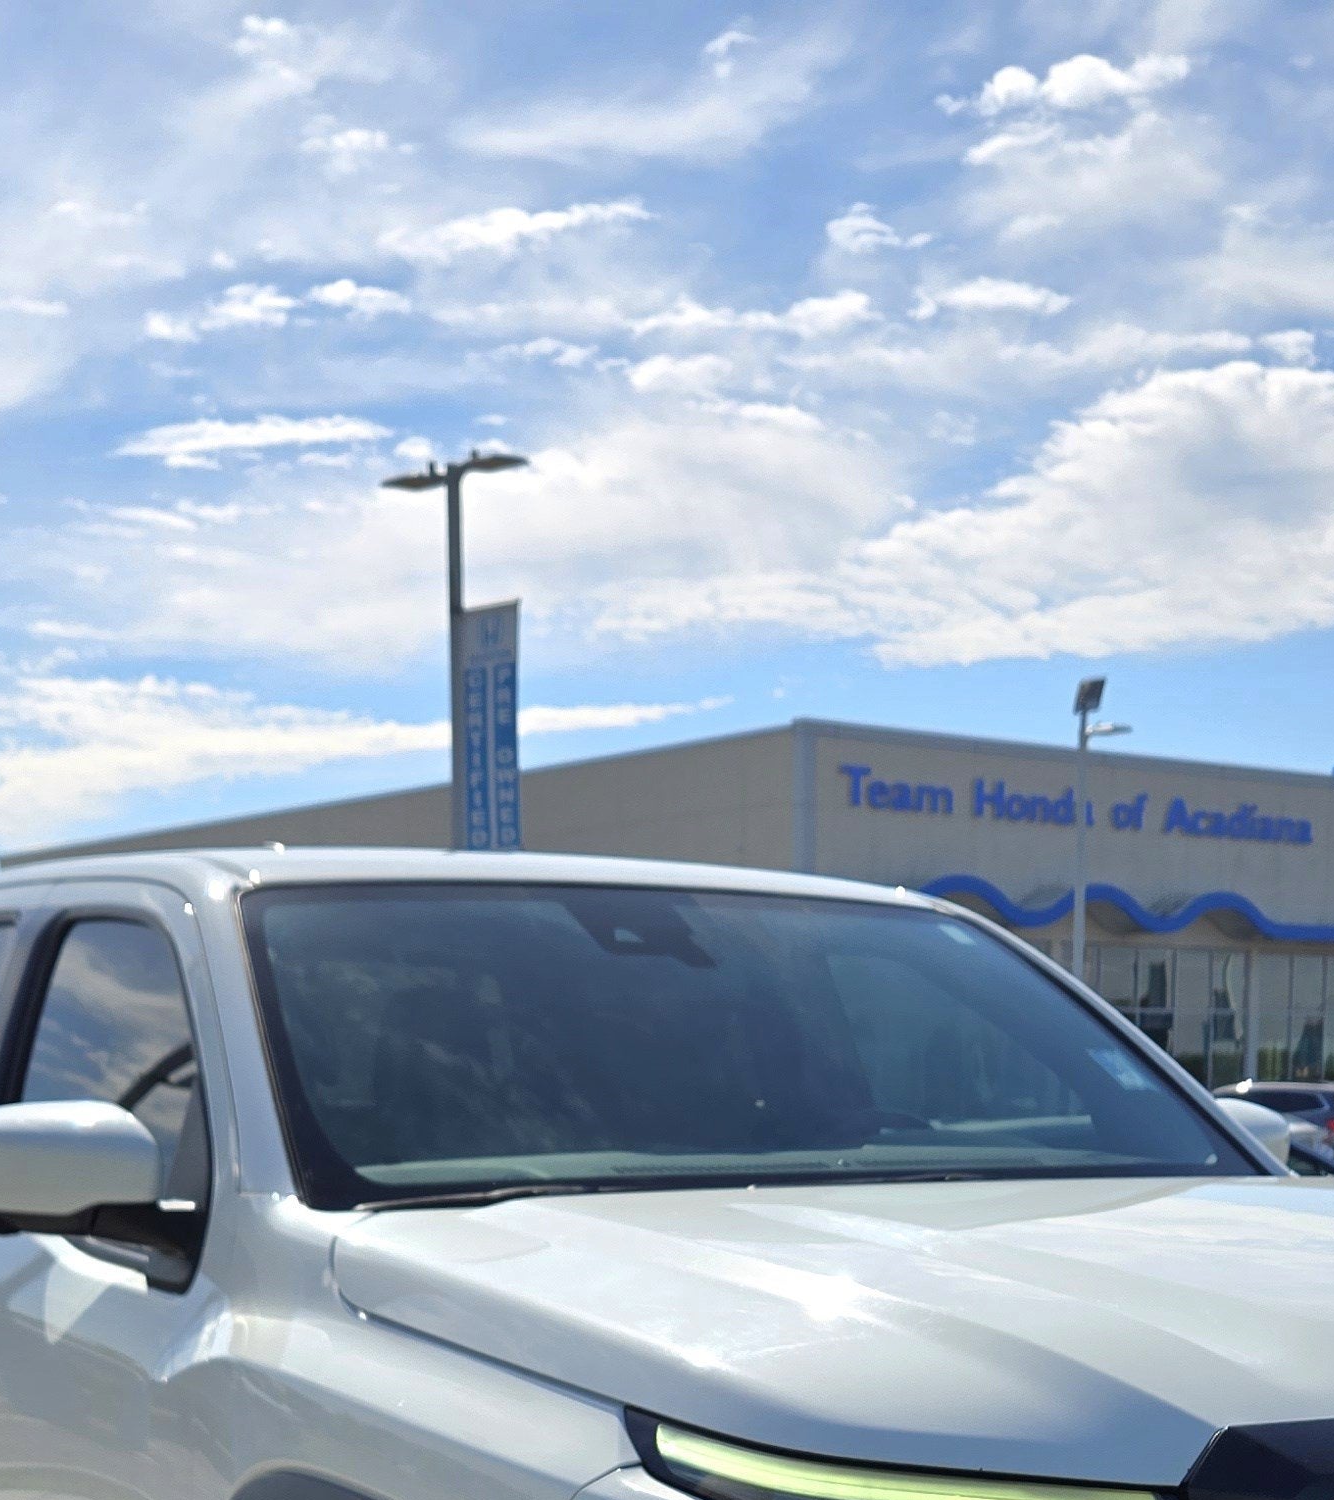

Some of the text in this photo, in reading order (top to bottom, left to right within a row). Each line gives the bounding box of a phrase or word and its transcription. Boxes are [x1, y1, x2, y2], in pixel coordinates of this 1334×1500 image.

[838, 763, 954, 815] Team
[1110, 791, 1149, 831] of
[1164, 796, 1313, 846] Acadiana
